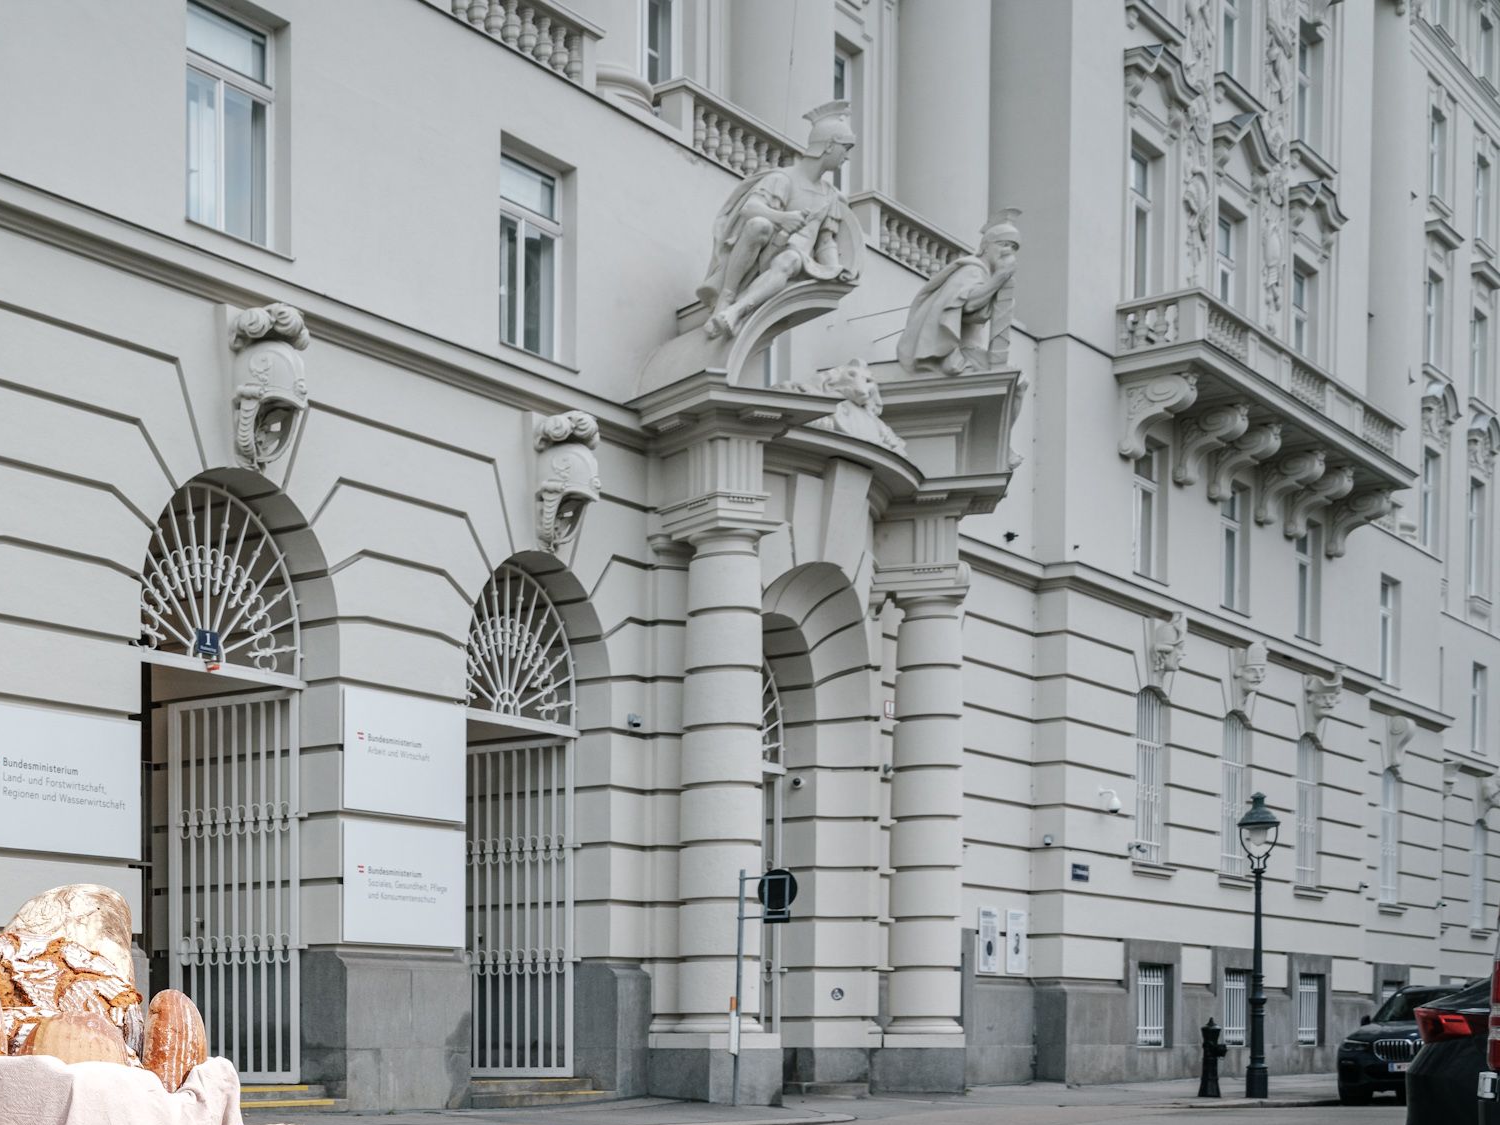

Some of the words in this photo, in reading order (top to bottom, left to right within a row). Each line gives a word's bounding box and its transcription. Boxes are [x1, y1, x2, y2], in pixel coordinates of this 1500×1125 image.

[205, 632, 211, 646] 1
[367, 733, 422, 748] Bundesministerium
[367, 746, 386, 756] Arbeit
[387, 749, 399, 758] und
[400, 750, 430, 761] Wirtschaft
[3, 757, 79, 776] Bundesministerium
[3, 772, 26, 783] Land-
[28, 776, 43, 786] und
[45, 777, 107, 795] Forstwirtschaft,
[2, 786, 40, 800] Regionen
[41, 792, 57, 802] und
[59, 793, 126, 811] Wasserwirtschaft
[367, 865, 422, 878] Bundesministerium
